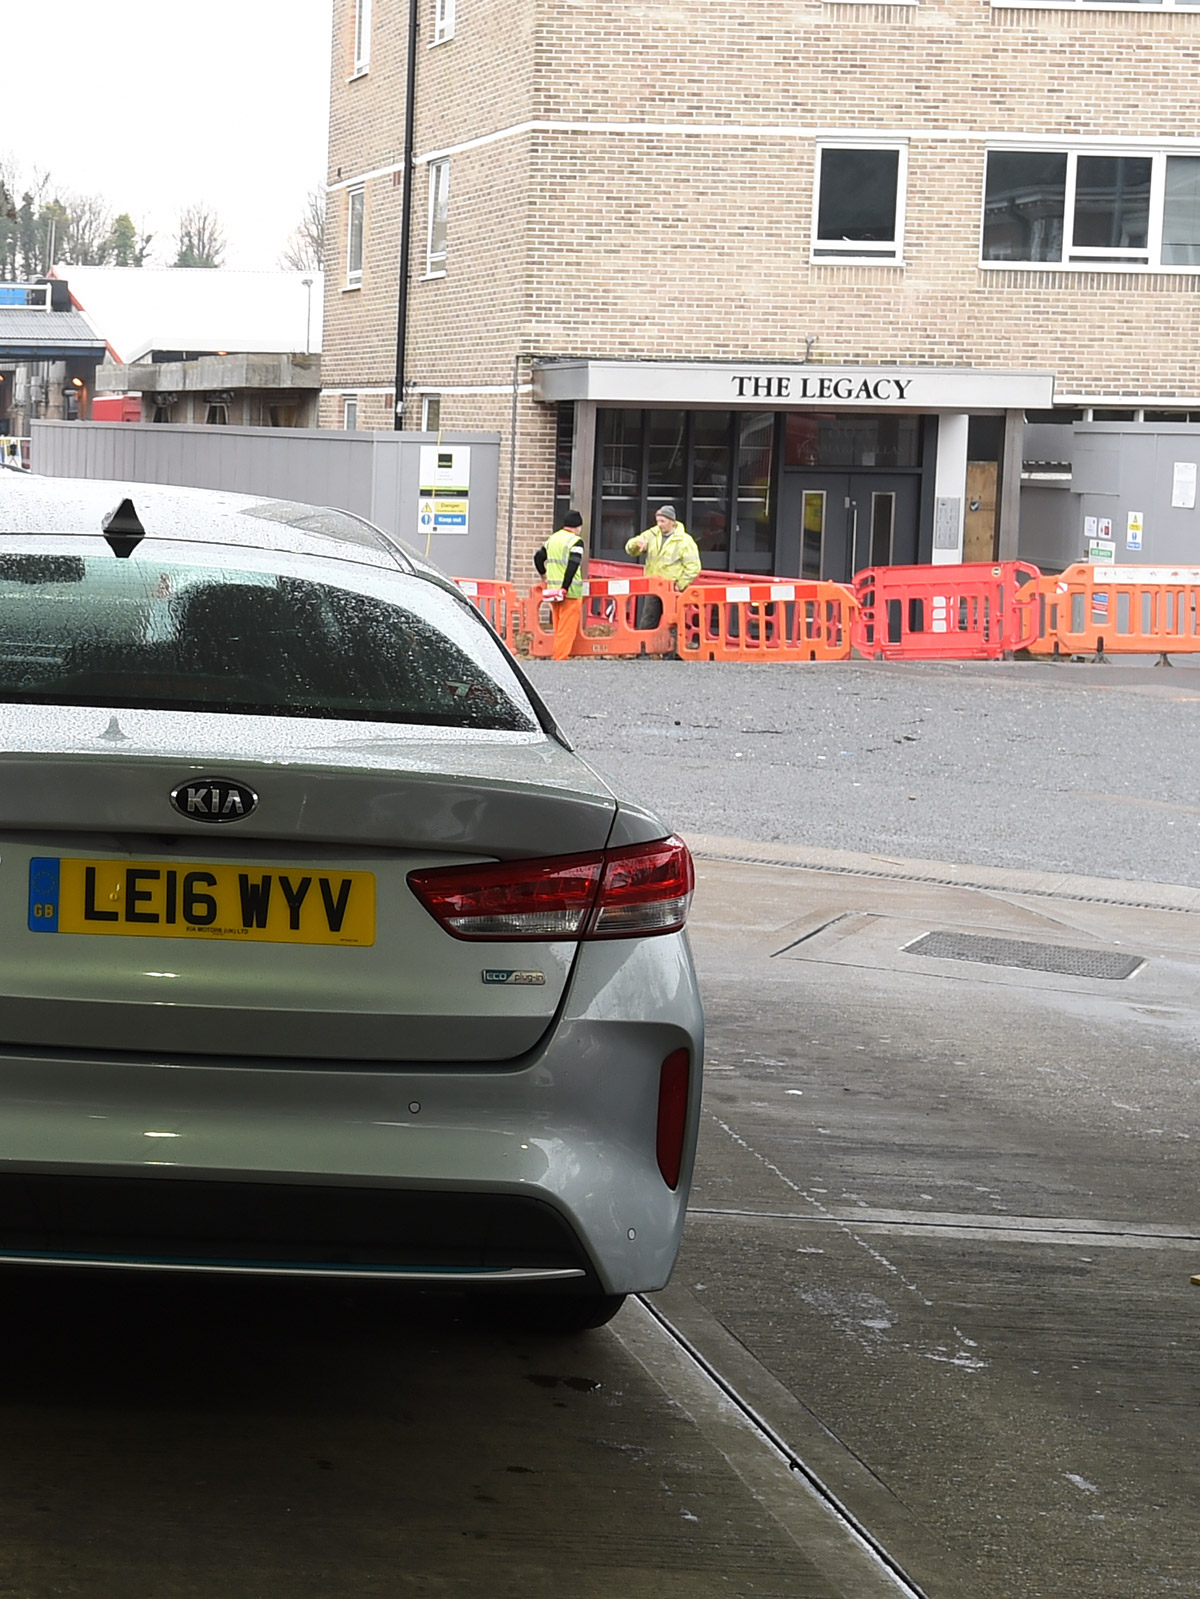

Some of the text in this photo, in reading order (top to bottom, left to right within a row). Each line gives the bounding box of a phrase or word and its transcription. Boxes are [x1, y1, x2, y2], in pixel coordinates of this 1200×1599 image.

[731, 375, 913, 400] THE LEGACY
[186, 788, 244, 813] KIA
[33, 903, 55, 919] GB
[84, 866, 353, 932] LE16 WYV
